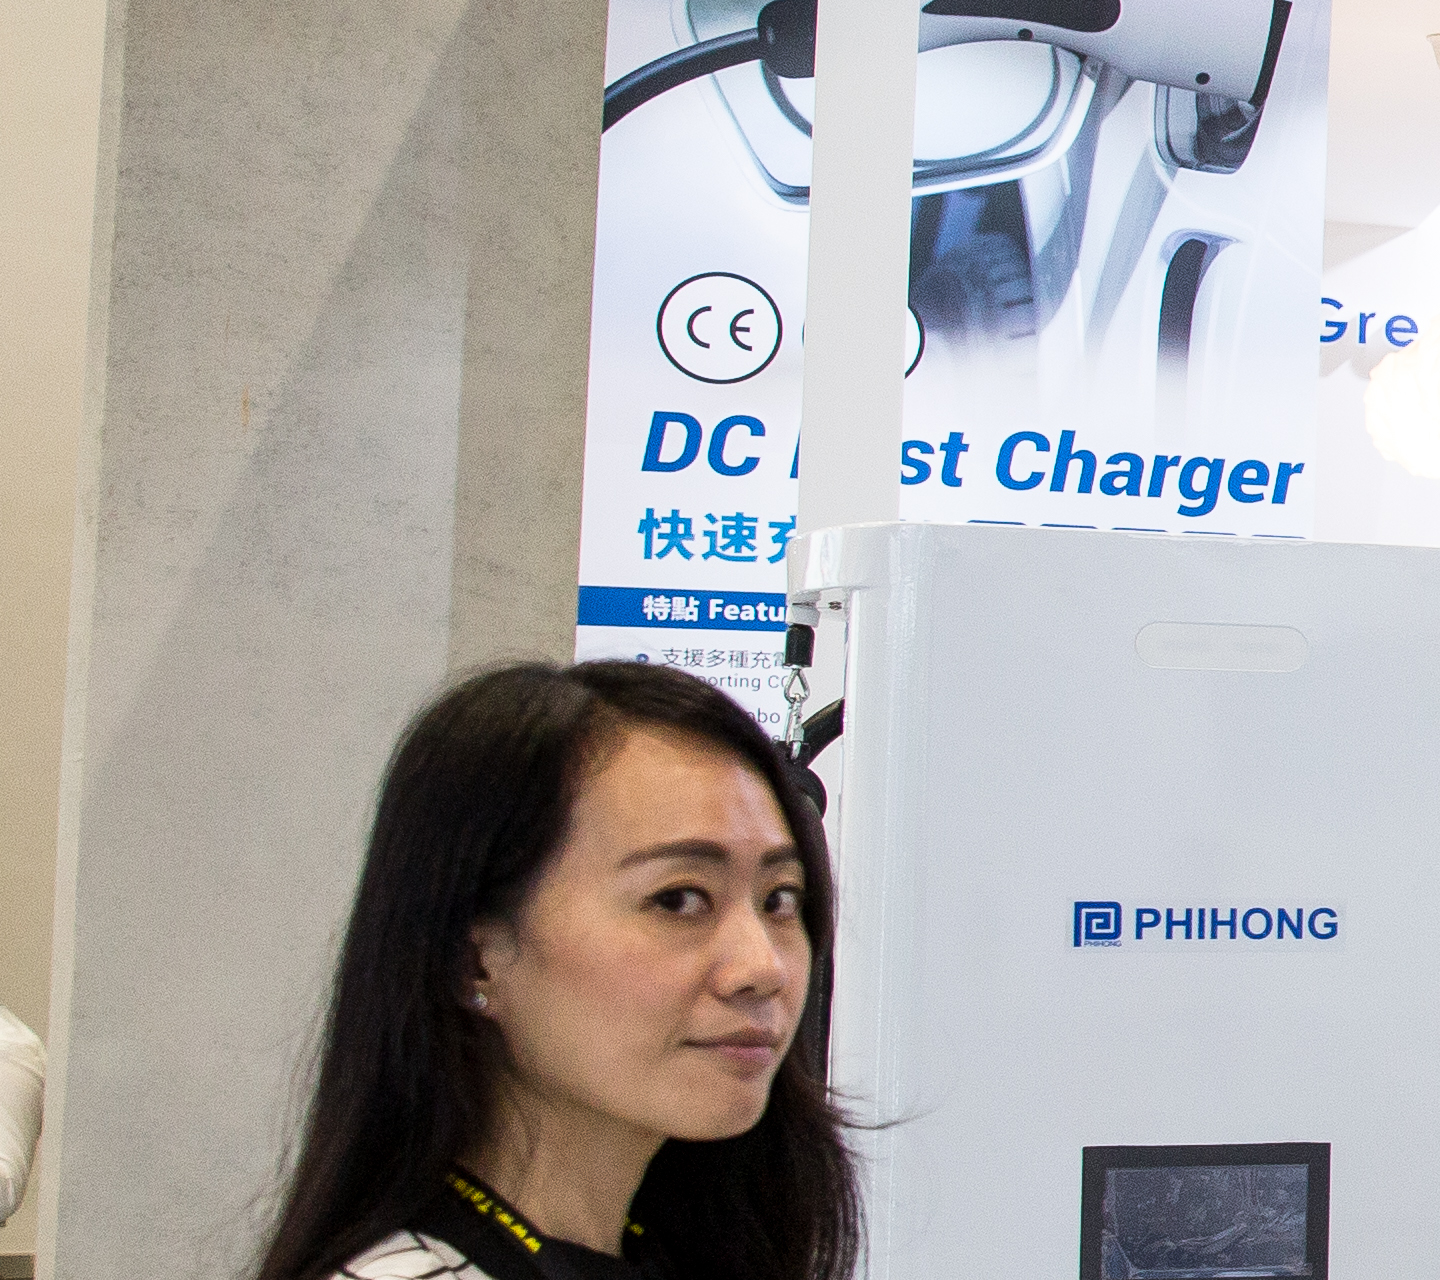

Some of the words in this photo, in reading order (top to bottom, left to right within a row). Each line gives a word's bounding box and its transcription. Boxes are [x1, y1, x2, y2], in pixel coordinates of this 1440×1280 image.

[641, 410, 766, 478] DC
[994, 430, 1305, 517] Charger
[642, 594, 700, 622] 特點
[1134, 907, 1339, 940] PHIHONG
